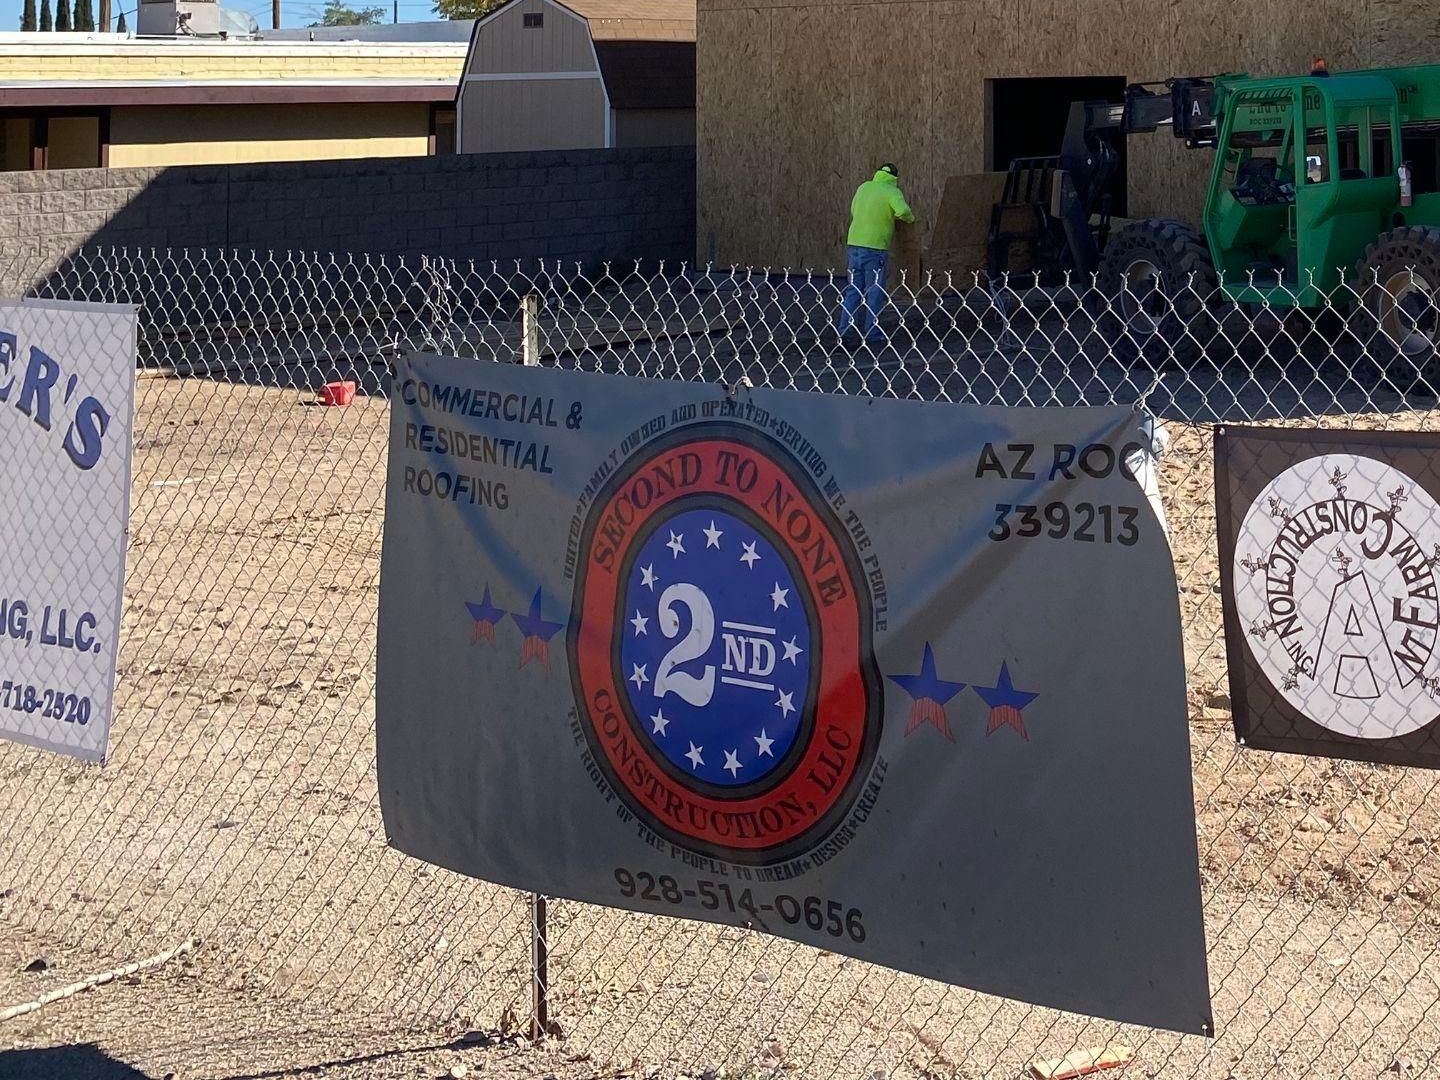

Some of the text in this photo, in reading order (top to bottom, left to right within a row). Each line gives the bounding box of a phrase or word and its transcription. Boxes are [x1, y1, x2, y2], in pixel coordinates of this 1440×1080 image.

[1191, 100, 1201, 117] A
[402, 378, 583, 430] COMMERCIAL &
[405, 422, 553, 474] RESIDENTIAL
[975, 442, 1036, 481] AZ
[404, 466, 509, 510] ROOFING
[579, 448, 620, 508] FAMILY
[620, 414, 667, 457] OWNED
[670, 403, 697, 426] AND
[702, 400, 771, 429] OPERATED
[776, 419, 828, 479] SERVING
[823, 475, 846, 511] WE
[845, 509, 872, 552] THE
[864, 552, 888, 633] PEOPLE
[594, 450, 848, 608] SECOND TO NONE
[987, 501, 1140, 547] 339213
[40, 605, 101, 654] LLC.
[0, 680, 91, 725] 718-2520
[594, 688, 852, 839] CONSTRUCTION, LLC
[567, 705, 889, 883] THE RIGHT OF THE PEOPLE TO DREAM DESIGN CREATE
[614, 867, 867, 944] 928-514-0656
